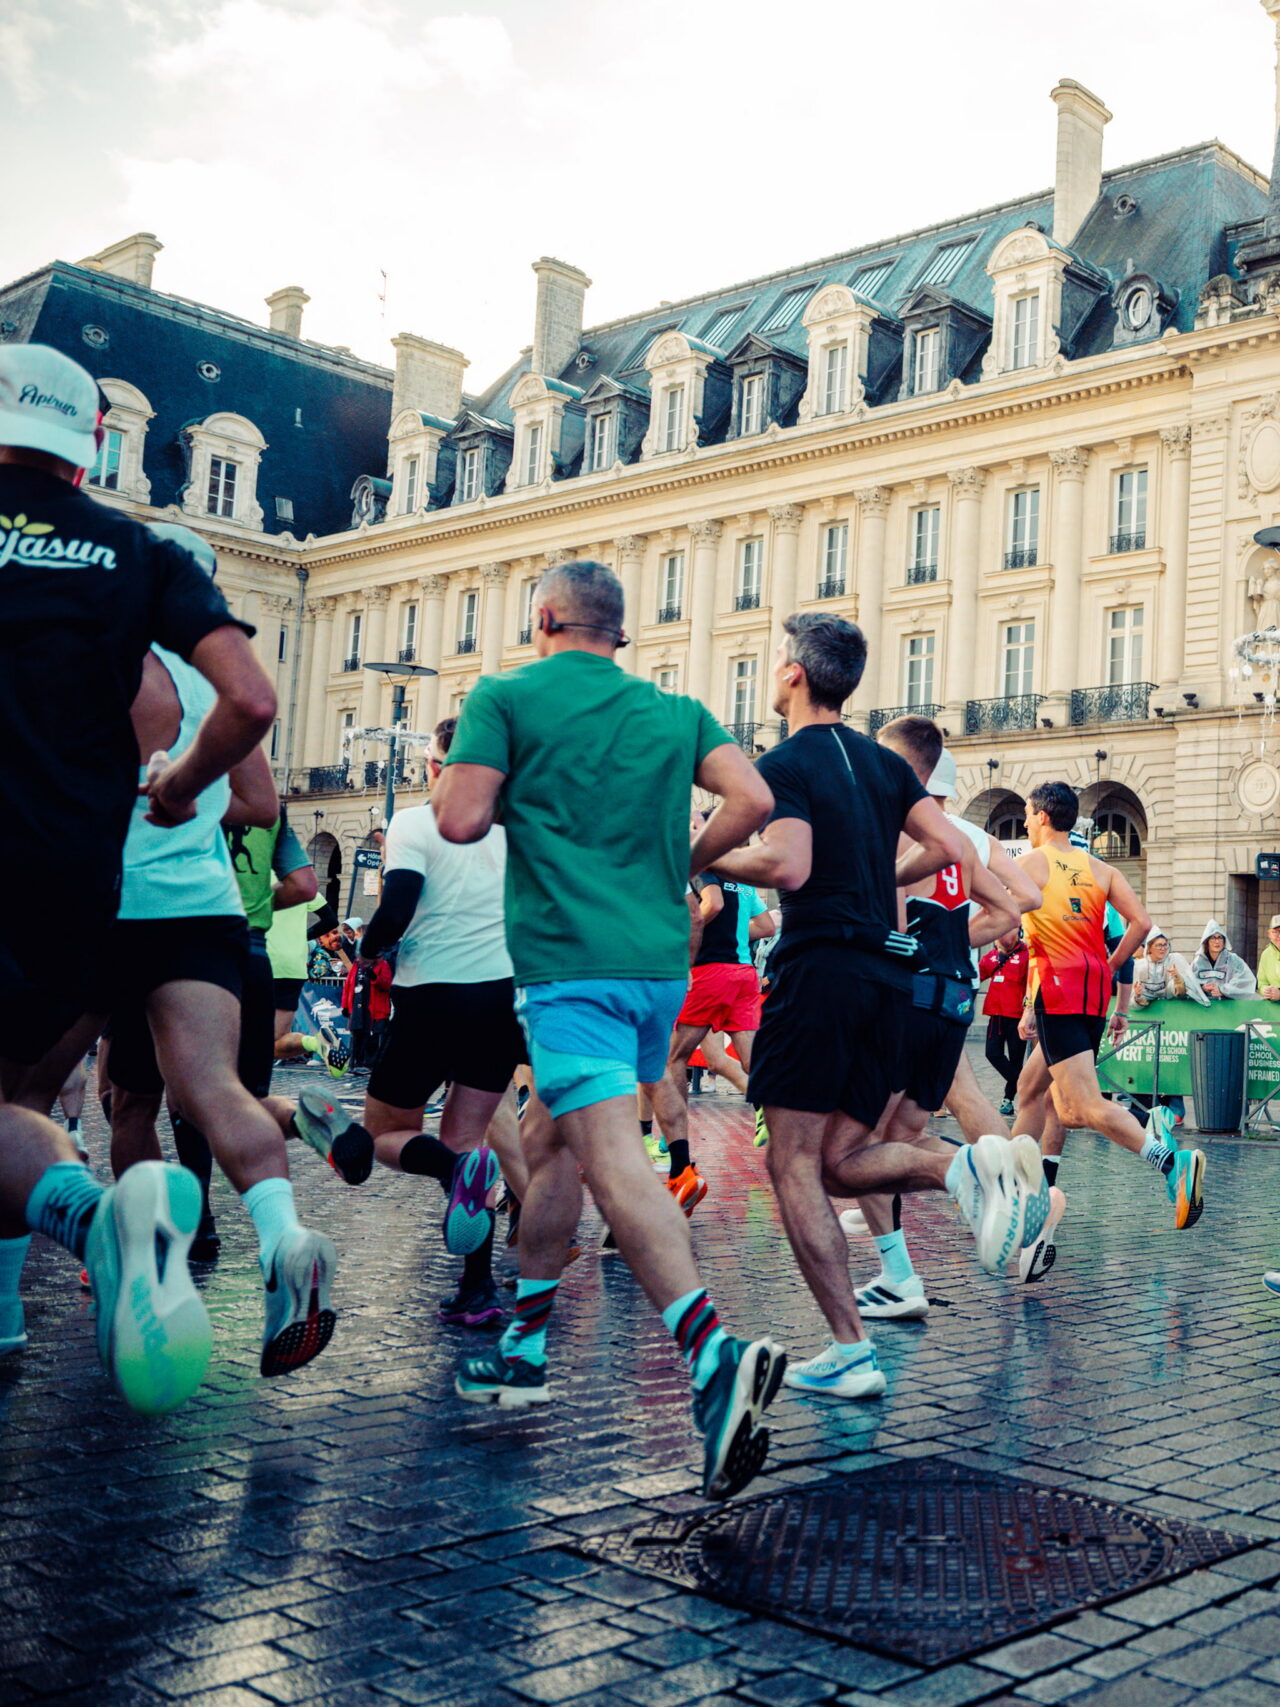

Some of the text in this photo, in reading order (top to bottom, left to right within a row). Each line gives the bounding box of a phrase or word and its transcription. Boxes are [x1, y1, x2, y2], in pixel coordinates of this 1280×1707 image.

[19, 384, 78, 416] Apirun
[1122, 1030, 1188, 1046] MARAHON
[1116, 1046, 1143, 1061] VERT
[1167, 1046, 1187, 1055] SCHOOL
[1249, 1051, 1273, 1060] CHOOL
[1249, 1059, 1280, 1068] BUSINESS
[1249, 1069, 1280, 1082] NFRAMED
